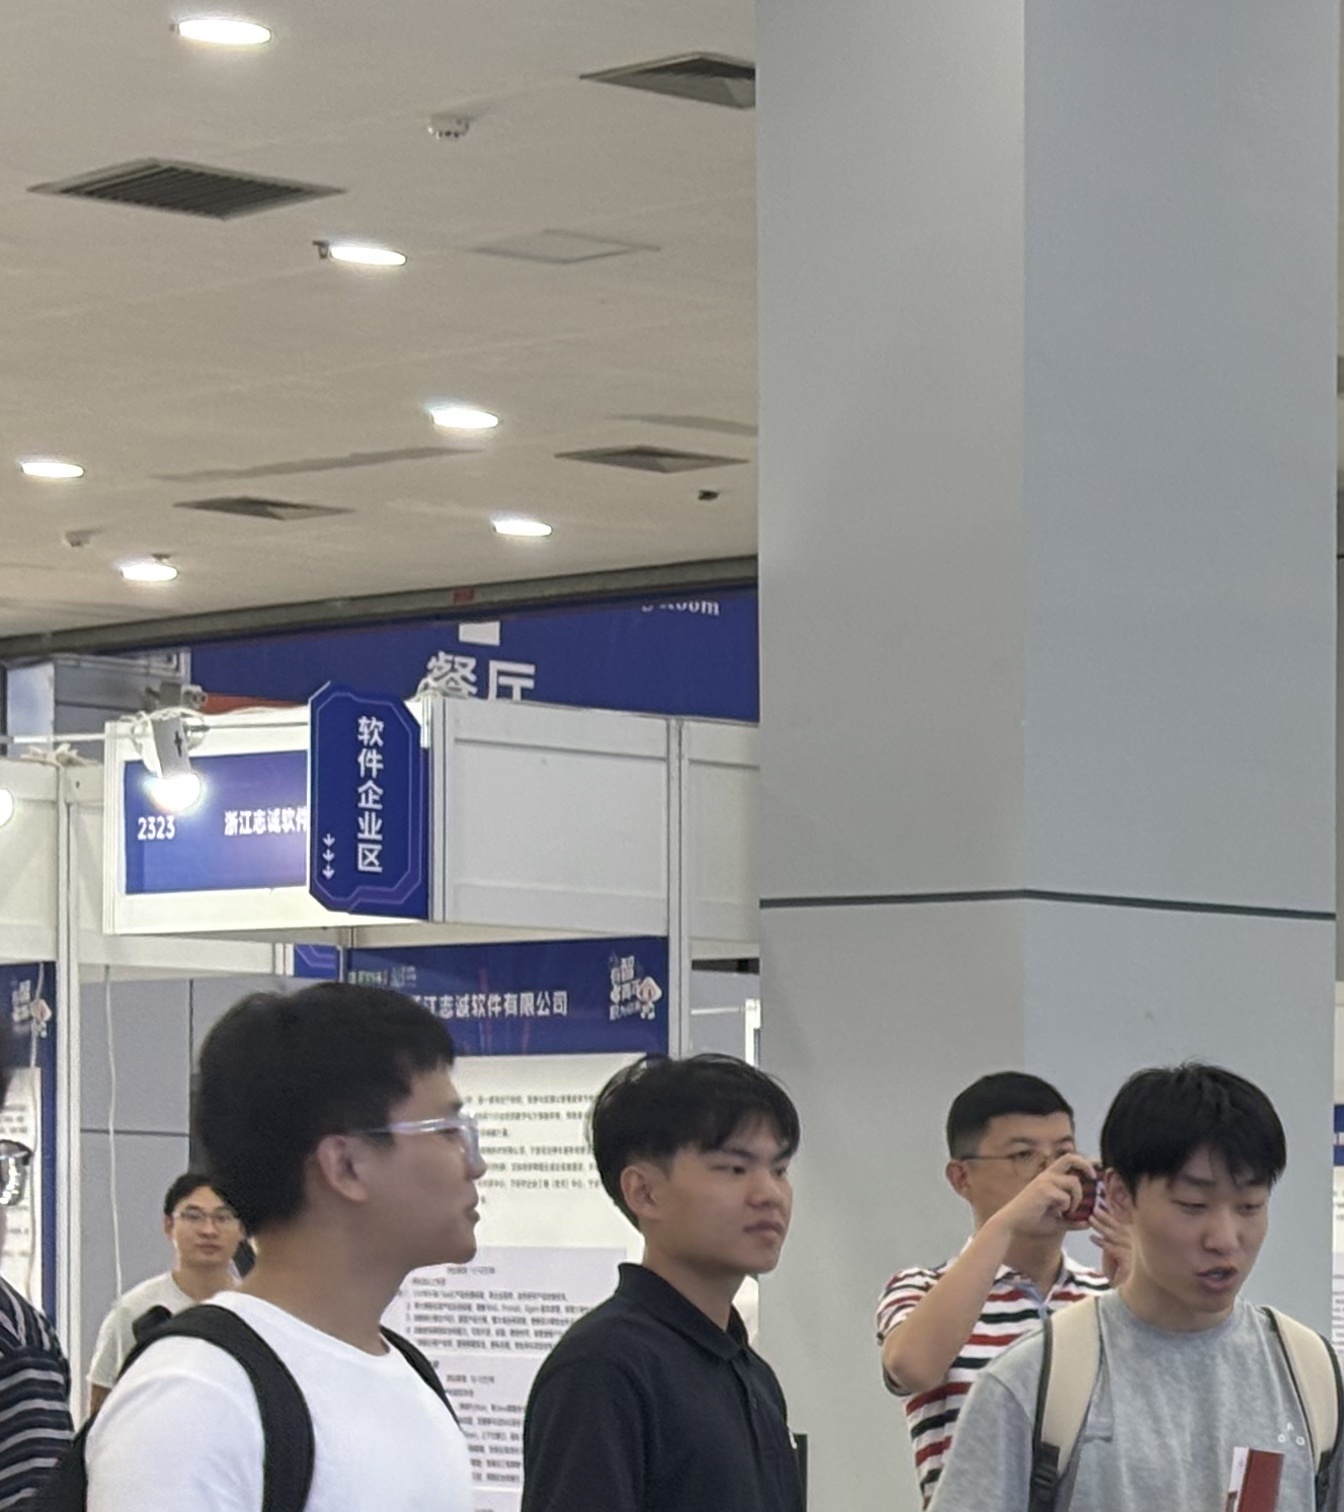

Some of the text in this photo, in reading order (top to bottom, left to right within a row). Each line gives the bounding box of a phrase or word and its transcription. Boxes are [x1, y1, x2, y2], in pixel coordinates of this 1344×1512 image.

[426, 650, 536, 702] 餐厅
[356, 715, 385, 874] 软件企业区
[136, 815, 176, 841] 2323
